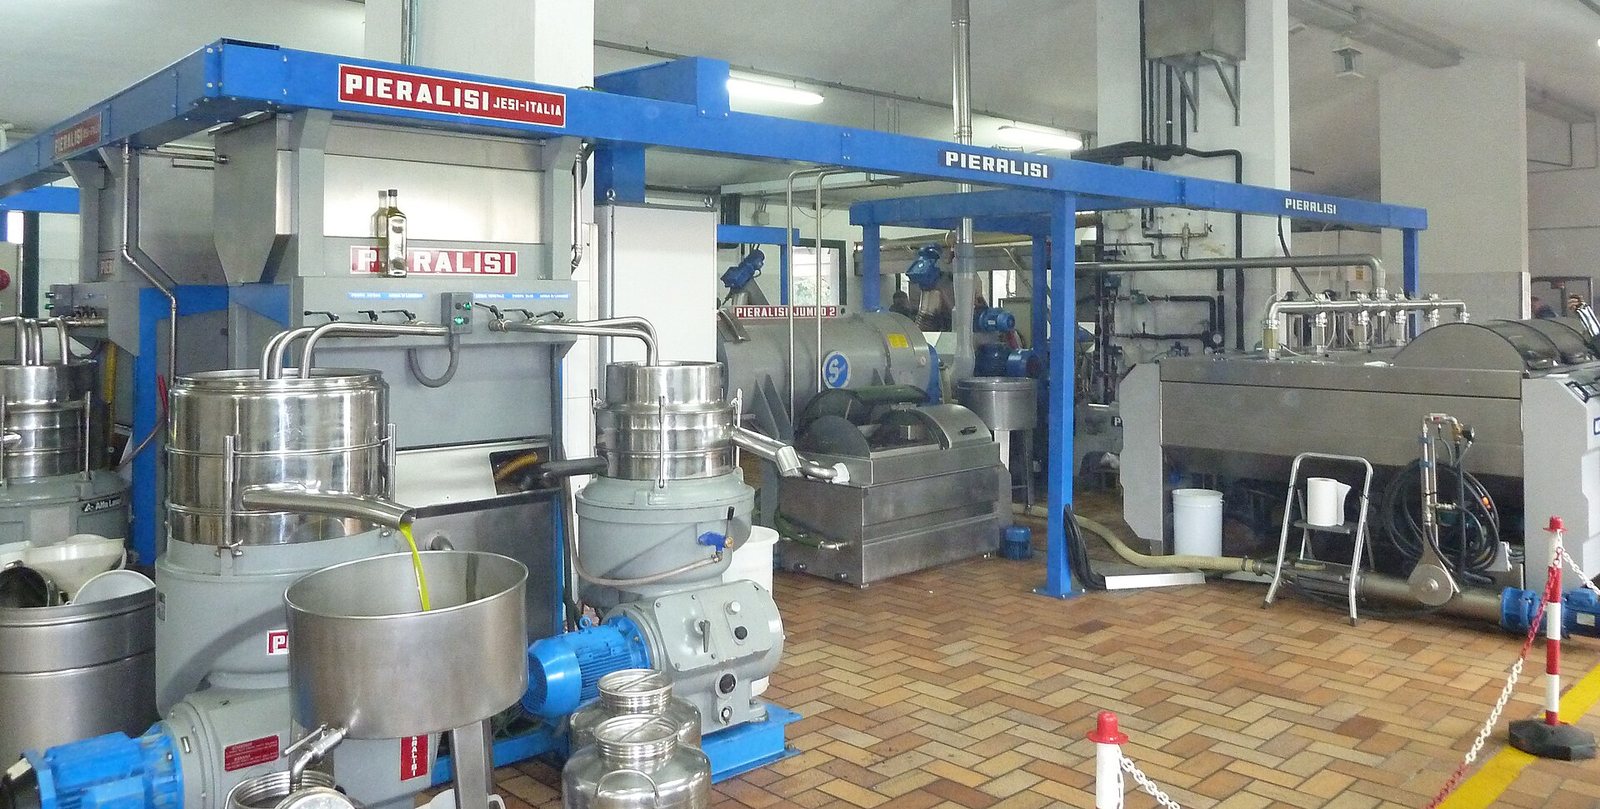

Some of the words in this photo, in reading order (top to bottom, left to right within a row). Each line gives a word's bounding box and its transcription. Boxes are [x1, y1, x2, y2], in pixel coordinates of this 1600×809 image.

[345, 73, 489, 111] PIERALISI
[493, 96, 562, 117] JESI-ITALIA
[945, 151, 1048, 179] PIERALISI
[1285, 197, 1337, 215] PIERALISI
[357, 249, 512, 274] PRALISI
[736, 307, 788, 318] PIERALISI
[829, 306, 837, 317] 2
